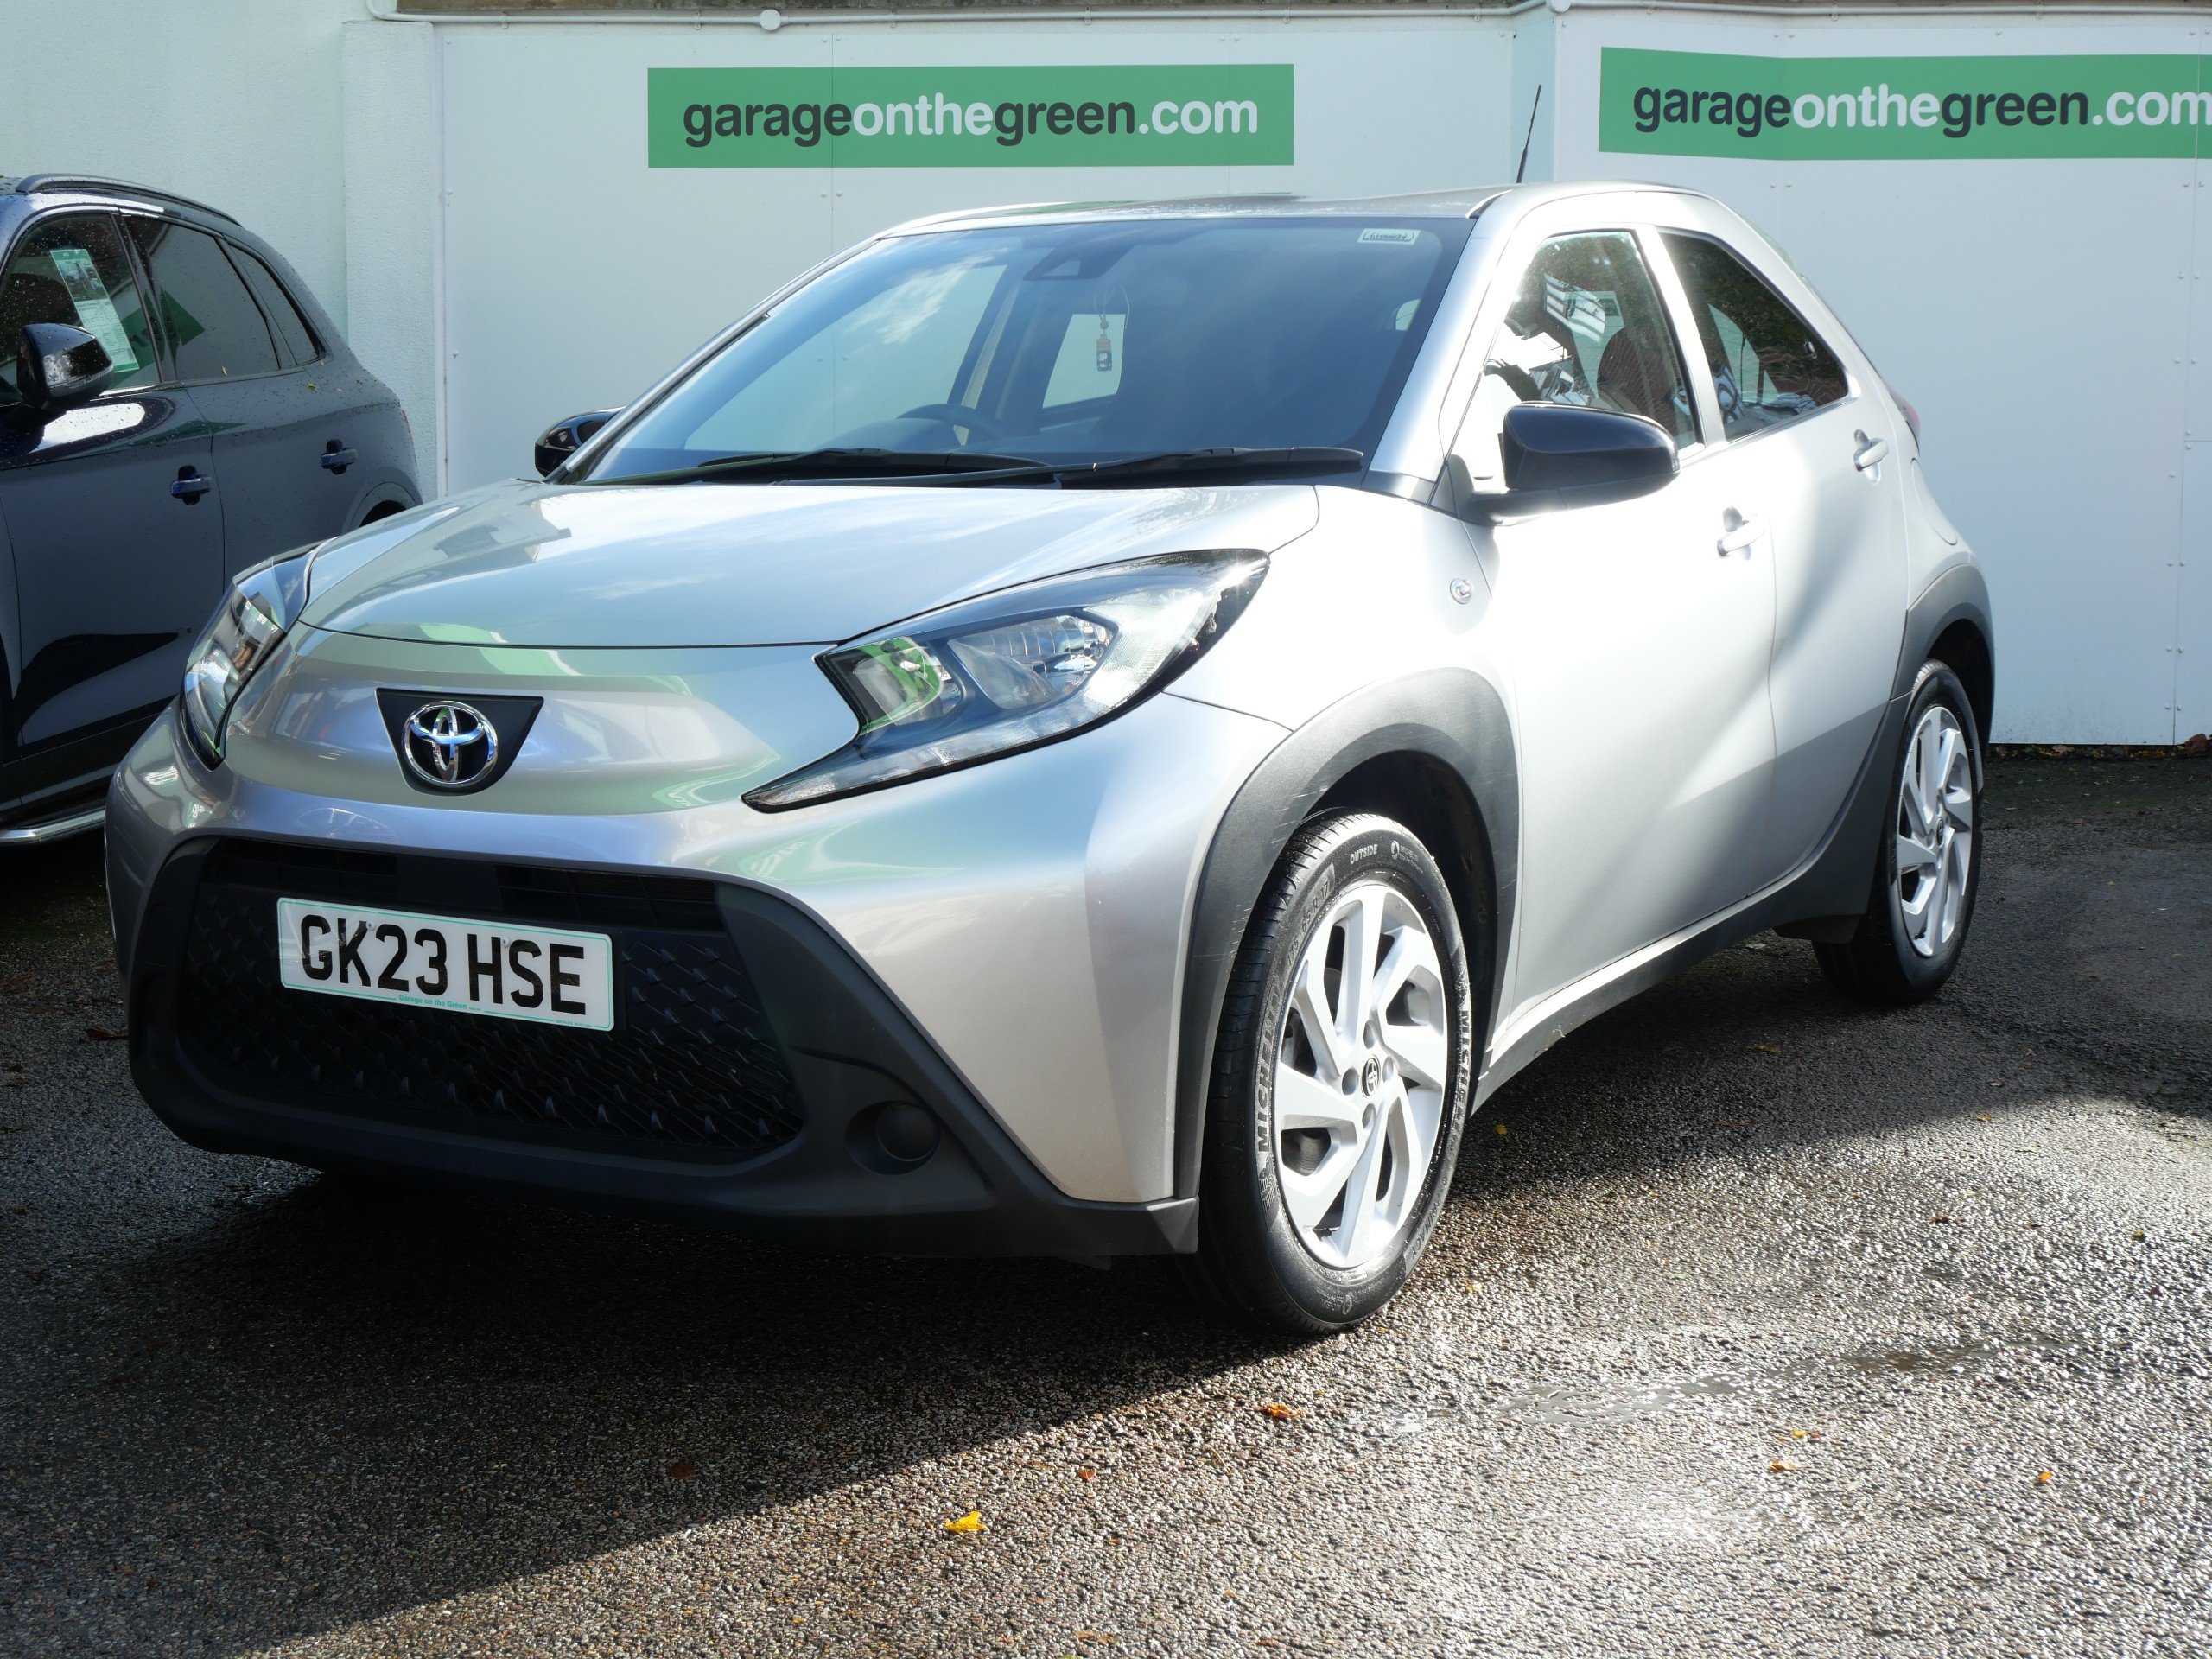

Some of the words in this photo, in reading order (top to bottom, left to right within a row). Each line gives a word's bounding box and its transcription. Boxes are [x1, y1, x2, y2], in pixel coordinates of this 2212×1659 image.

[683, 92, 1258, 148] garageonthegreen.com
[1633, 83, 2212, 138] garageonthegreen.com
[1350, 843, 1378, 865] OUTSIDE
[300, 914, 448, 996] GK23
[467, 933, 587, 1016] HSE
[398, 994, 423, 1004] Garage
[447, 1001, 467, 1010] Green
[1258, 982, 1286, 1153] MICHELIN
